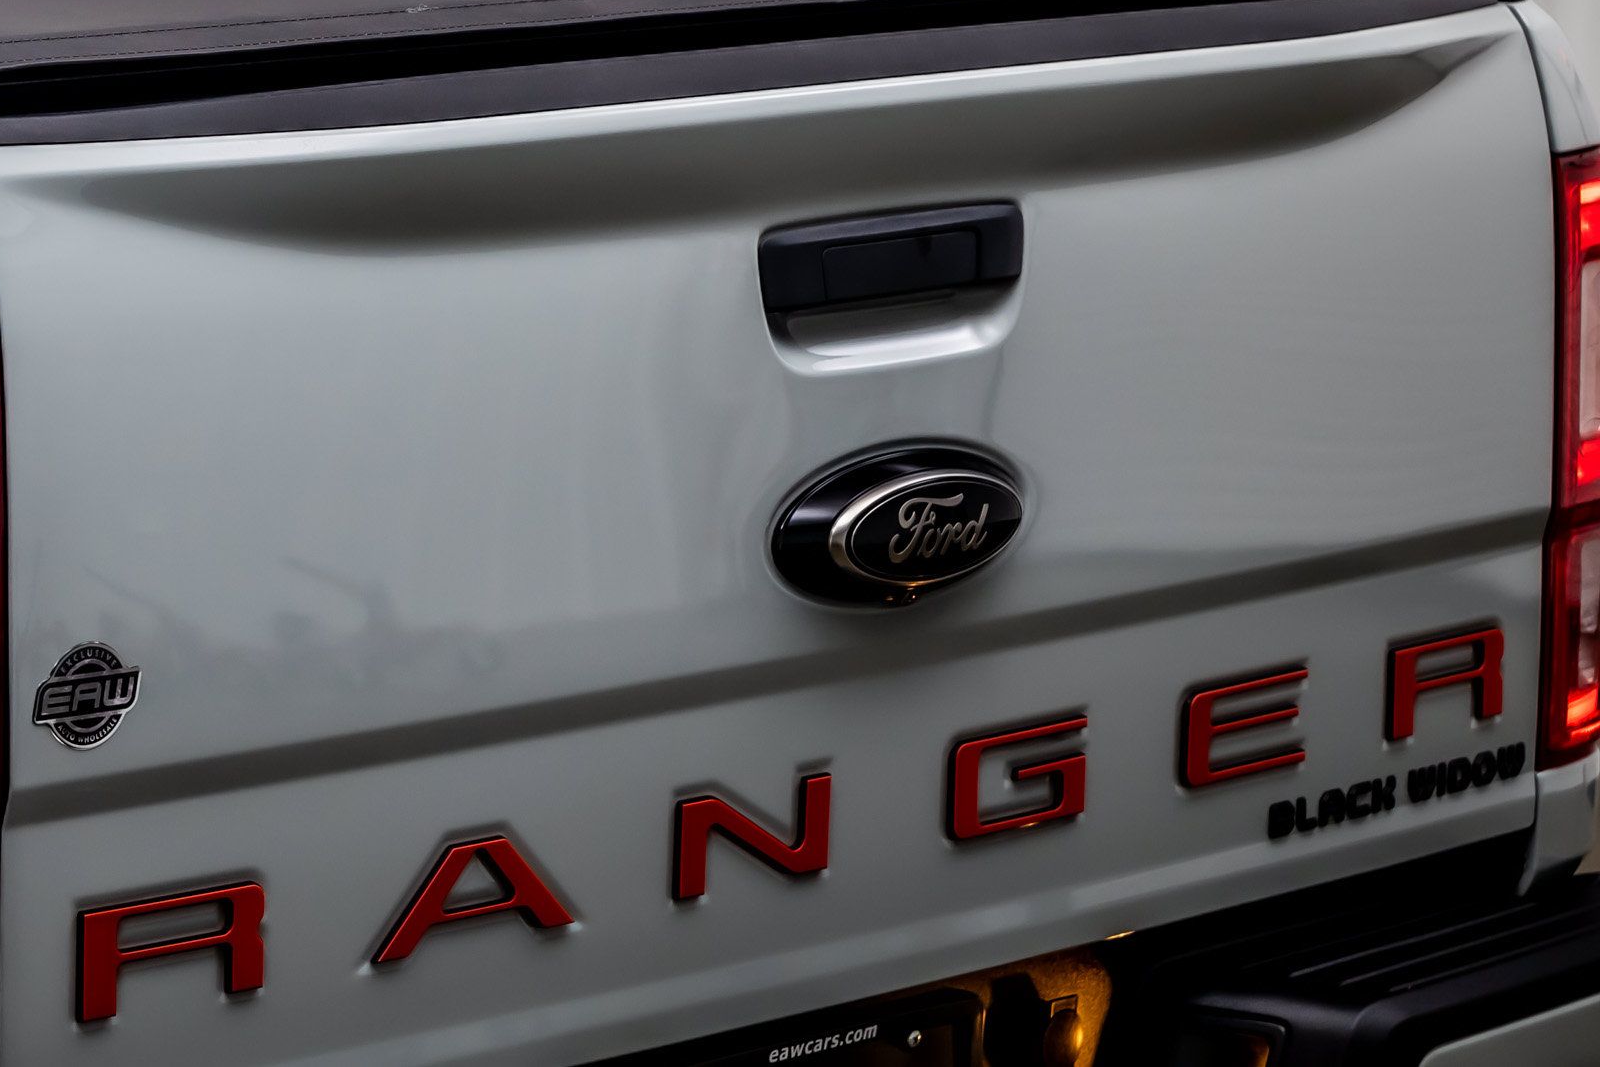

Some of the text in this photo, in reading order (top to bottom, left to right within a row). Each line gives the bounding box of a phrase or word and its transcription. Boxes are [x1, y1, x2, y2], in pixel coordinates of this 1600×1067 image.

[889, 493, 990, 563] Ford
[60, 649, 117, 673] EXCLUSIVE
[41, 676, 135, 715] EAW
[1268, 742, 1526, 839] BLACK WIDOW
[75, 626, 1504, 1022] RANGER
[768, 1024, 878, 1063] eawcars.com
